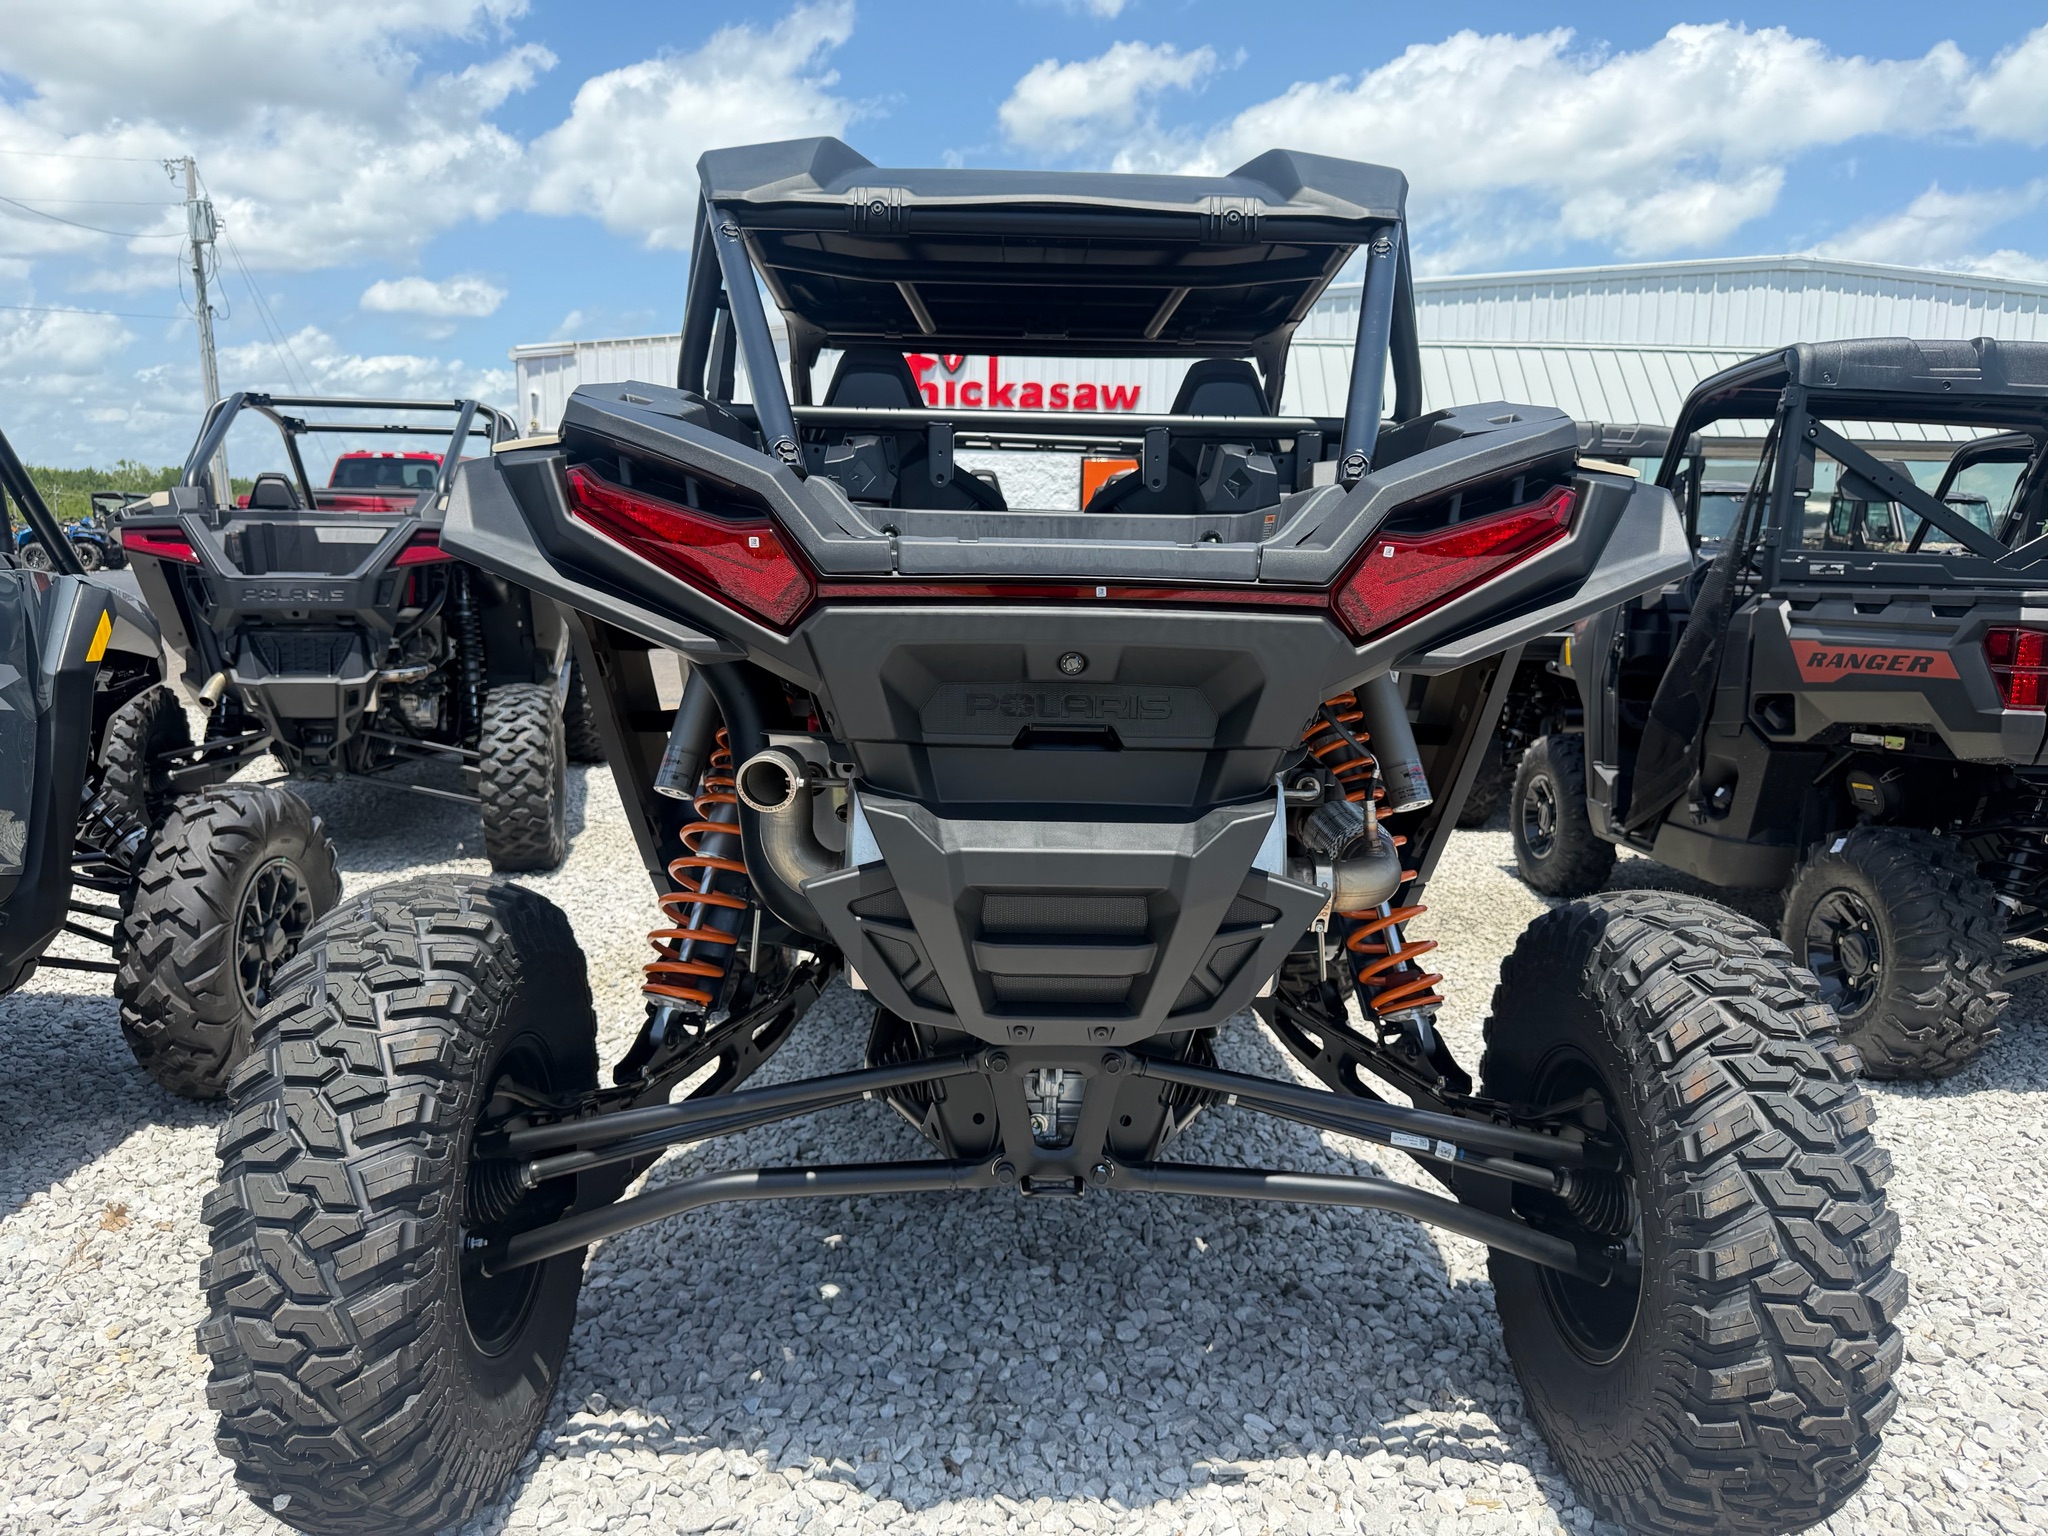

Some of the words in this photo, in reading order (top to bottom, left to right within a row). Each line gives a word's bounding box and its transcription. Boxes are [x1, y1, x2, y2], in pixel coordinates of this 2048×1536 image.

[906, 354, 1141, 411] hickasaw
[242, 588, 345, 602] POLARIS
[1806, 652, 1935, 673] RANGER
[966, 692, 1173, 720] POLARIS
